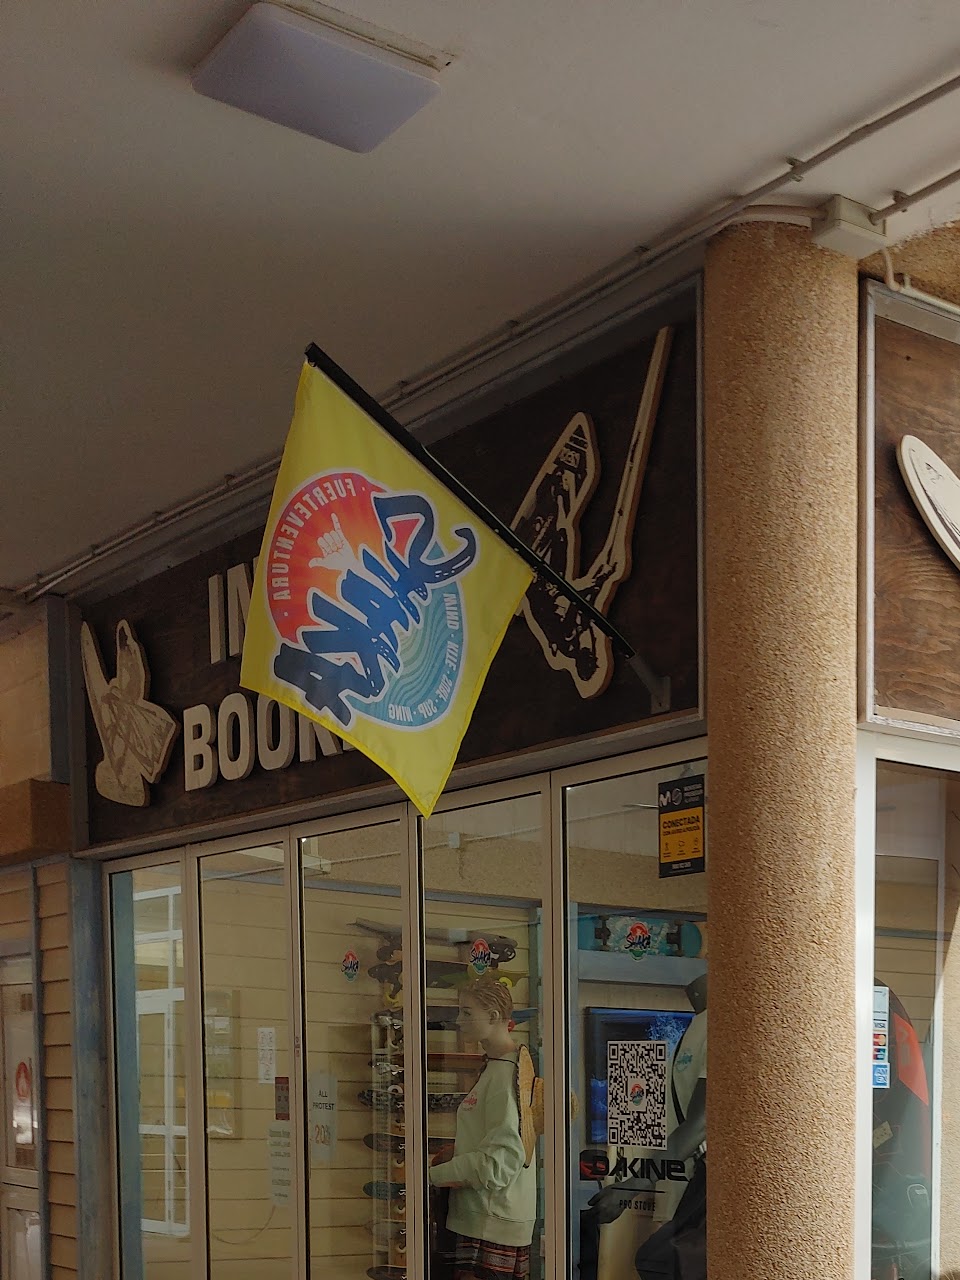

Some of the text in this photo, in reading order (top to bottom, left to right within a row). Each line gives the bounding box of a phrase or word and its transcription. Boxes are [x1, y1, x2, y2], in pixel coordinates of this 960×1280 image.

[208, 556, 259, 665] IN
[183, 692, 353, 792] BOOK
[662, 815, 701, 829] CONECTADA
[873, 1021, 886, 1029] VISA
[318, 1090, 328, 1099] ALL
[312, 1102, 335, 1111] PROTEST
[619, 1199, 656, 1212] PRO STORE
